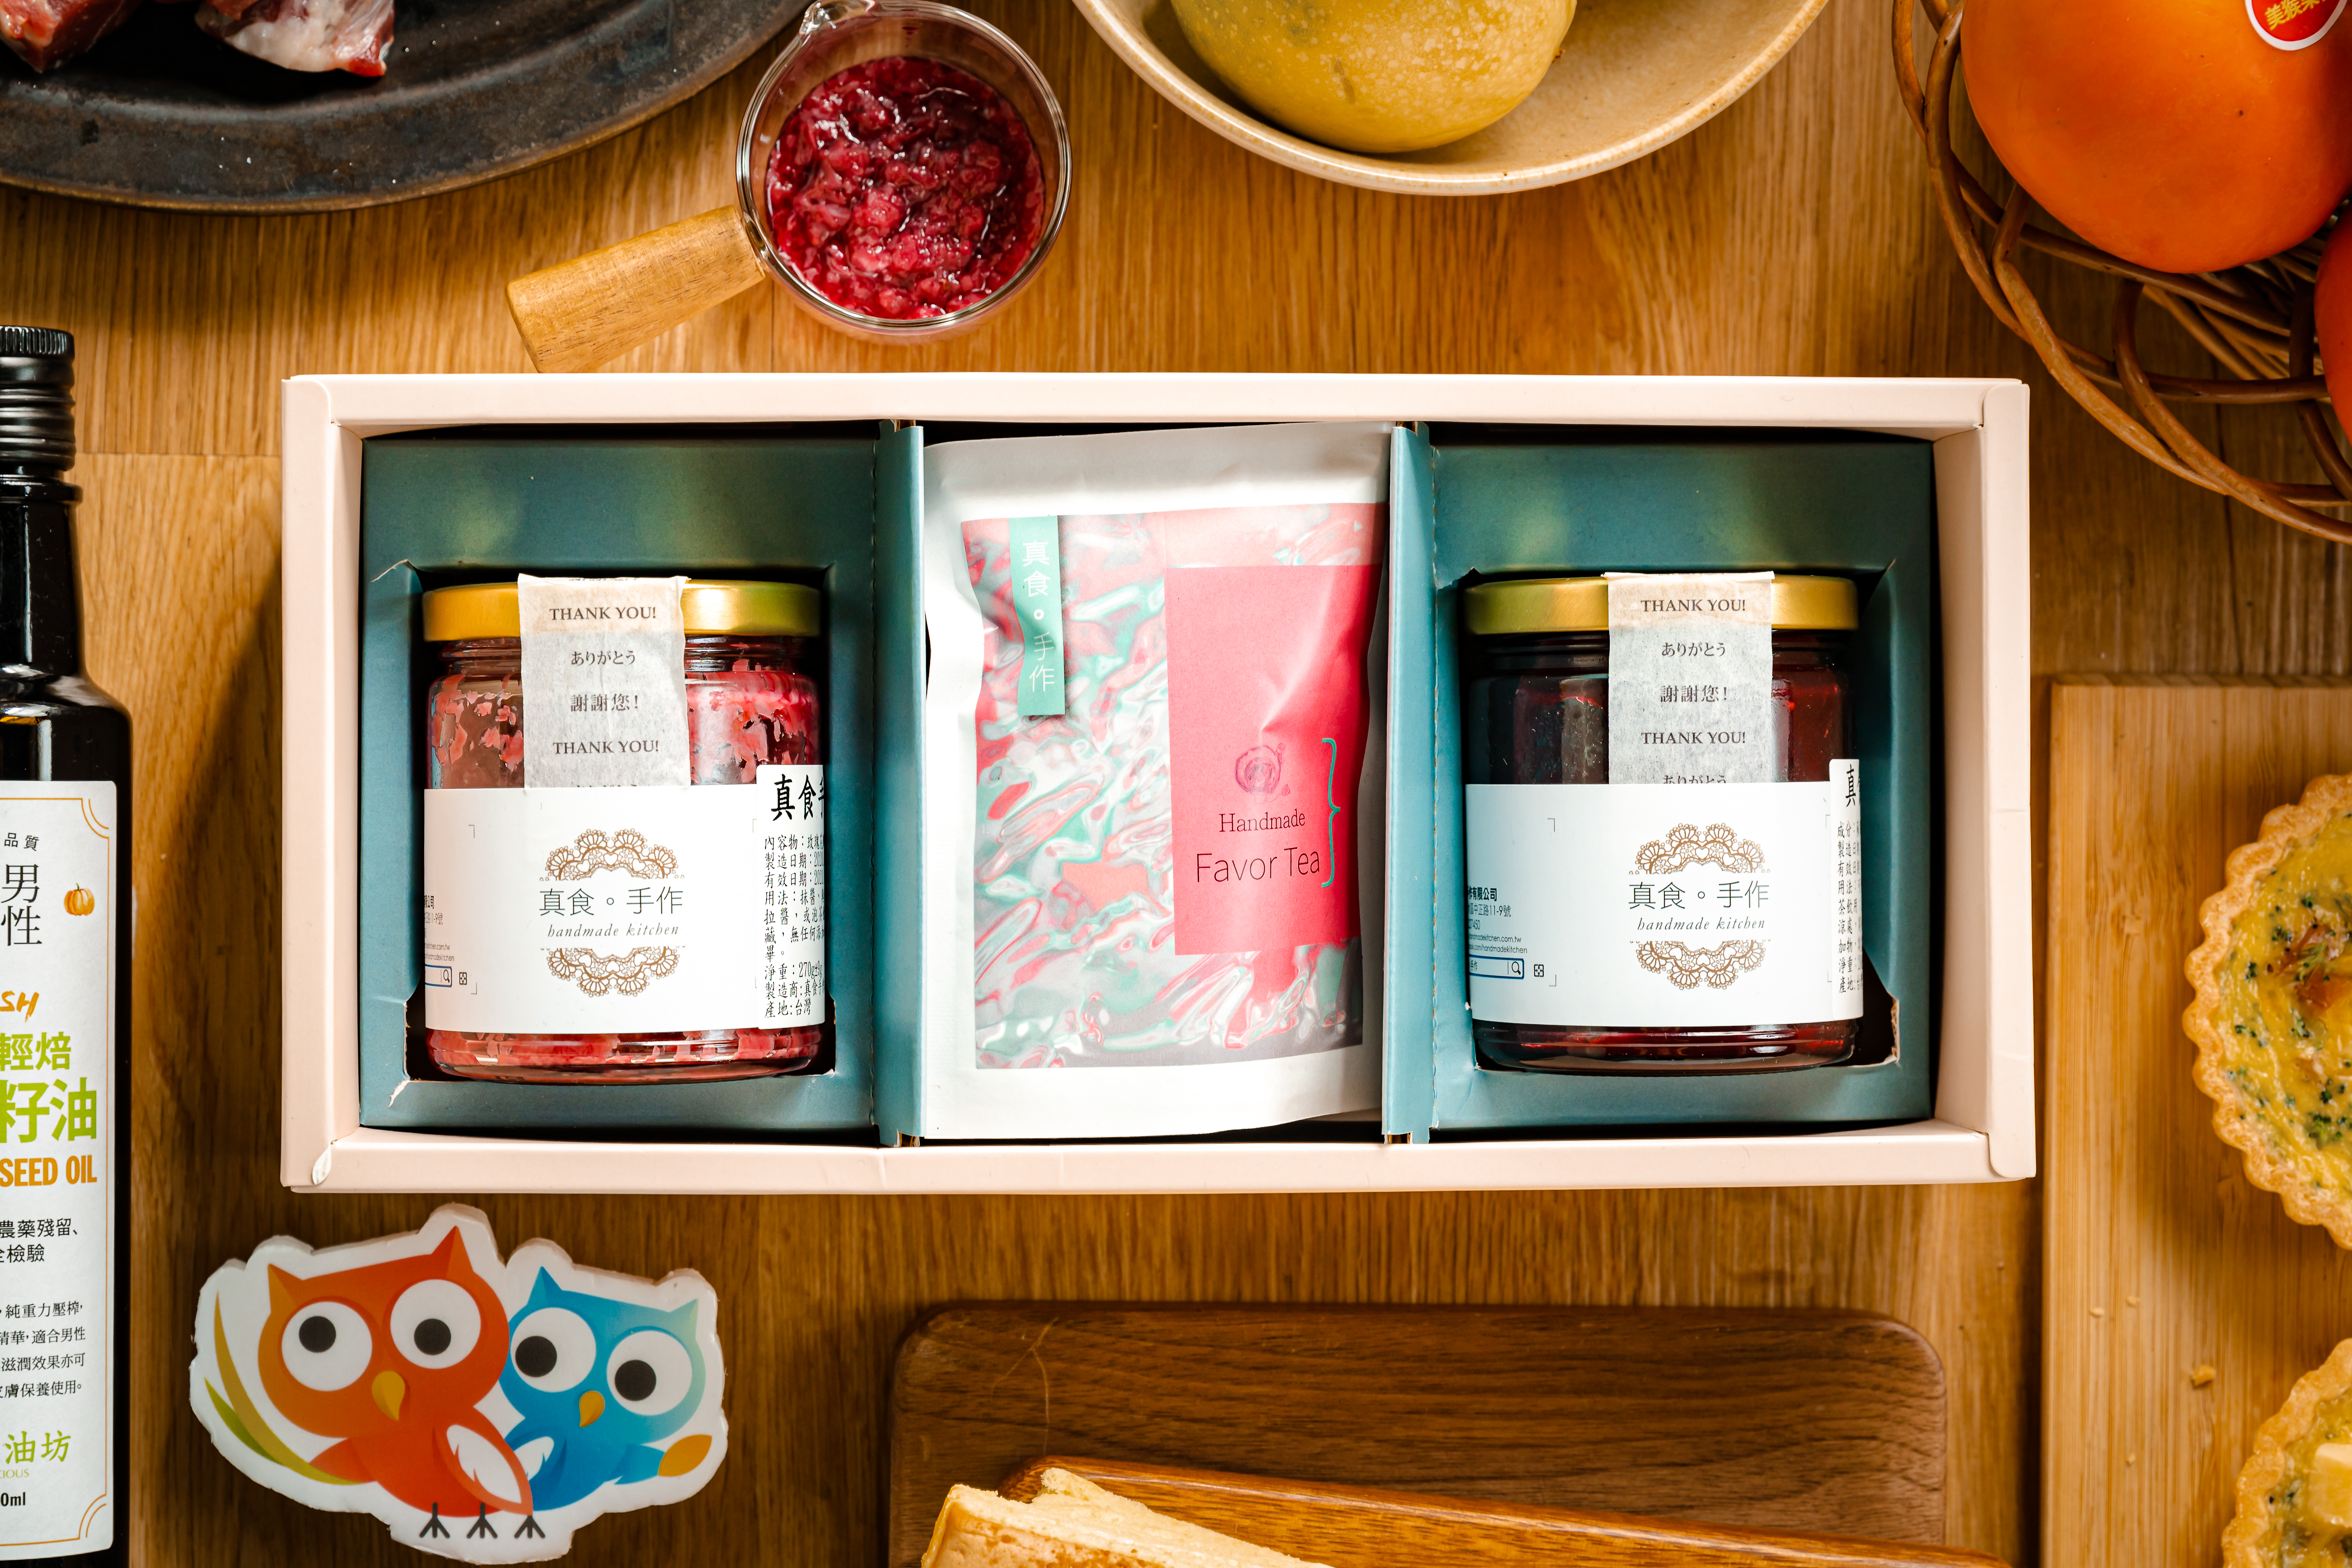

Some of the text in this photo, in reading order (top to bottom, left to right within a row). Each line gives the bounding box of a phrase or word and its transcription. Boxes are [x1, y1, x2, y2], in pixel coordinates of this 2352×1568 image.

[549, 607, 656, 620] THANK YOU!
[1641, 599, 1746, 612] THANK YOU!
[571, 650, 635, 666] ありがとう
[1662, 642, 1726, 657] ありがとう
[570, 693, 638, 712] 謝謝您！
[1660, 685, 1727, 703] 謝謝您！
[553, 740, 659, 754] THANK YOU!
[1641, 732, 1746, 744] THANK YOU!
[1219, 808, 1305, 832] Handmade
[4, 832, 39, 851] 品質
[1196, 847, 1320, 883] Favor Tea
[1, 864, 42, 946] 男性
[547, 923, 679, 937] handmade kitchen
[1637, 917, 1765, 930] handmade kitchen
[0, 1154, 97, 1186] SEED OIL
[0, 1244, 45, 1263] 檢驗
[1, 1353, 85, 1371] 滋潤效果亦可
[0, 1380, 81, 1398] 膚保養使用。
[5, 1430, 71, 1464] 油坊
[0, 1469, 29, 1478] IOUS
[0, 1492, 25, 1507] 0ml
